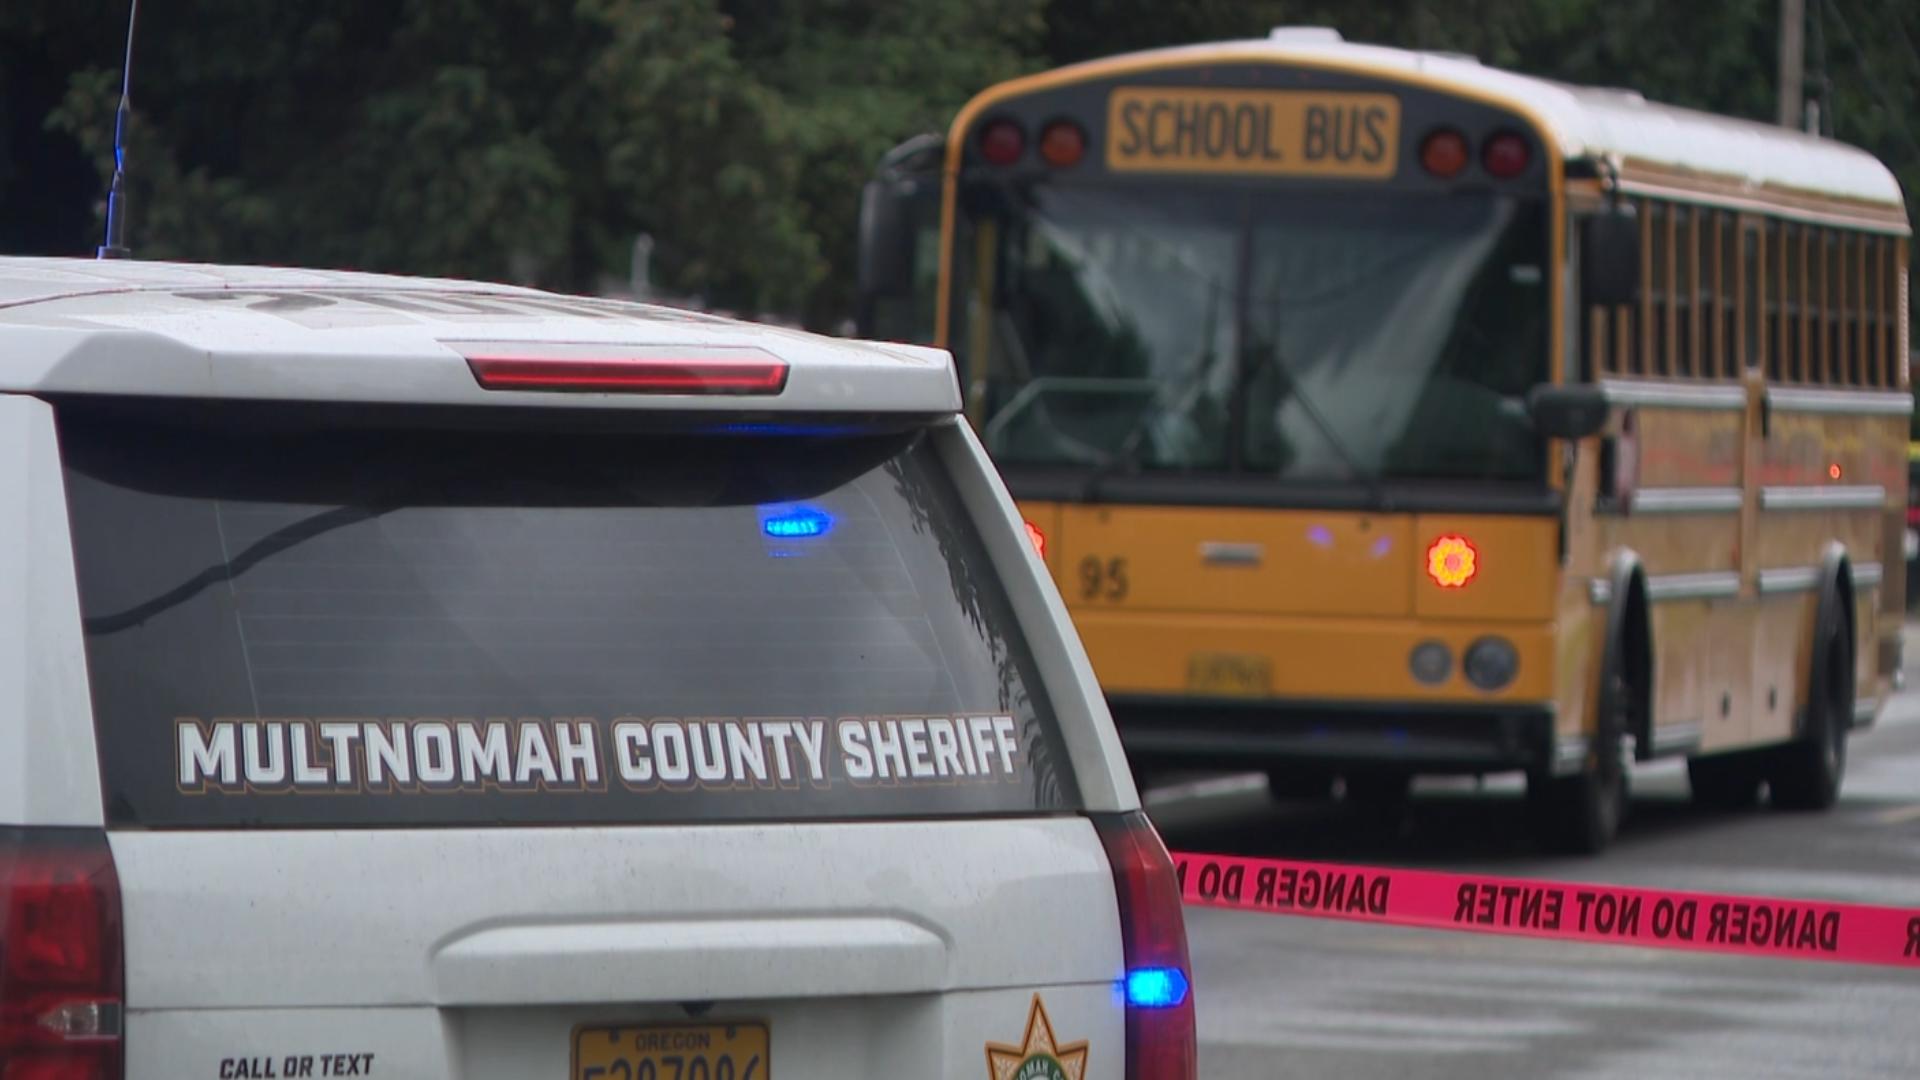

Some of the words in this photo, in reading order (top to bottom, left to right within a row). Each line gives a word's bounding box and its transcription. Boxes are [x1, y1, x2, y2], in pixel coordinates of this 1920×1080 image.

[1119, 97, 1284, 162] SCHOOL
[1304, 103, 1389, 164] BUS
[1077, 555, 1130, 602] 95
[176, 719, 602, 788] MULTNOMAH
[612, 718, 828, 786] COUNTY
[837, 714, 1020, 782] SHERIFF
[635, 1032, 711, 1051] OREGON
[219, 1057, 276, 1080] CALL
[283, 1055, 314, 1078] OR
[320, 1053, 375, 1077] TEXT
